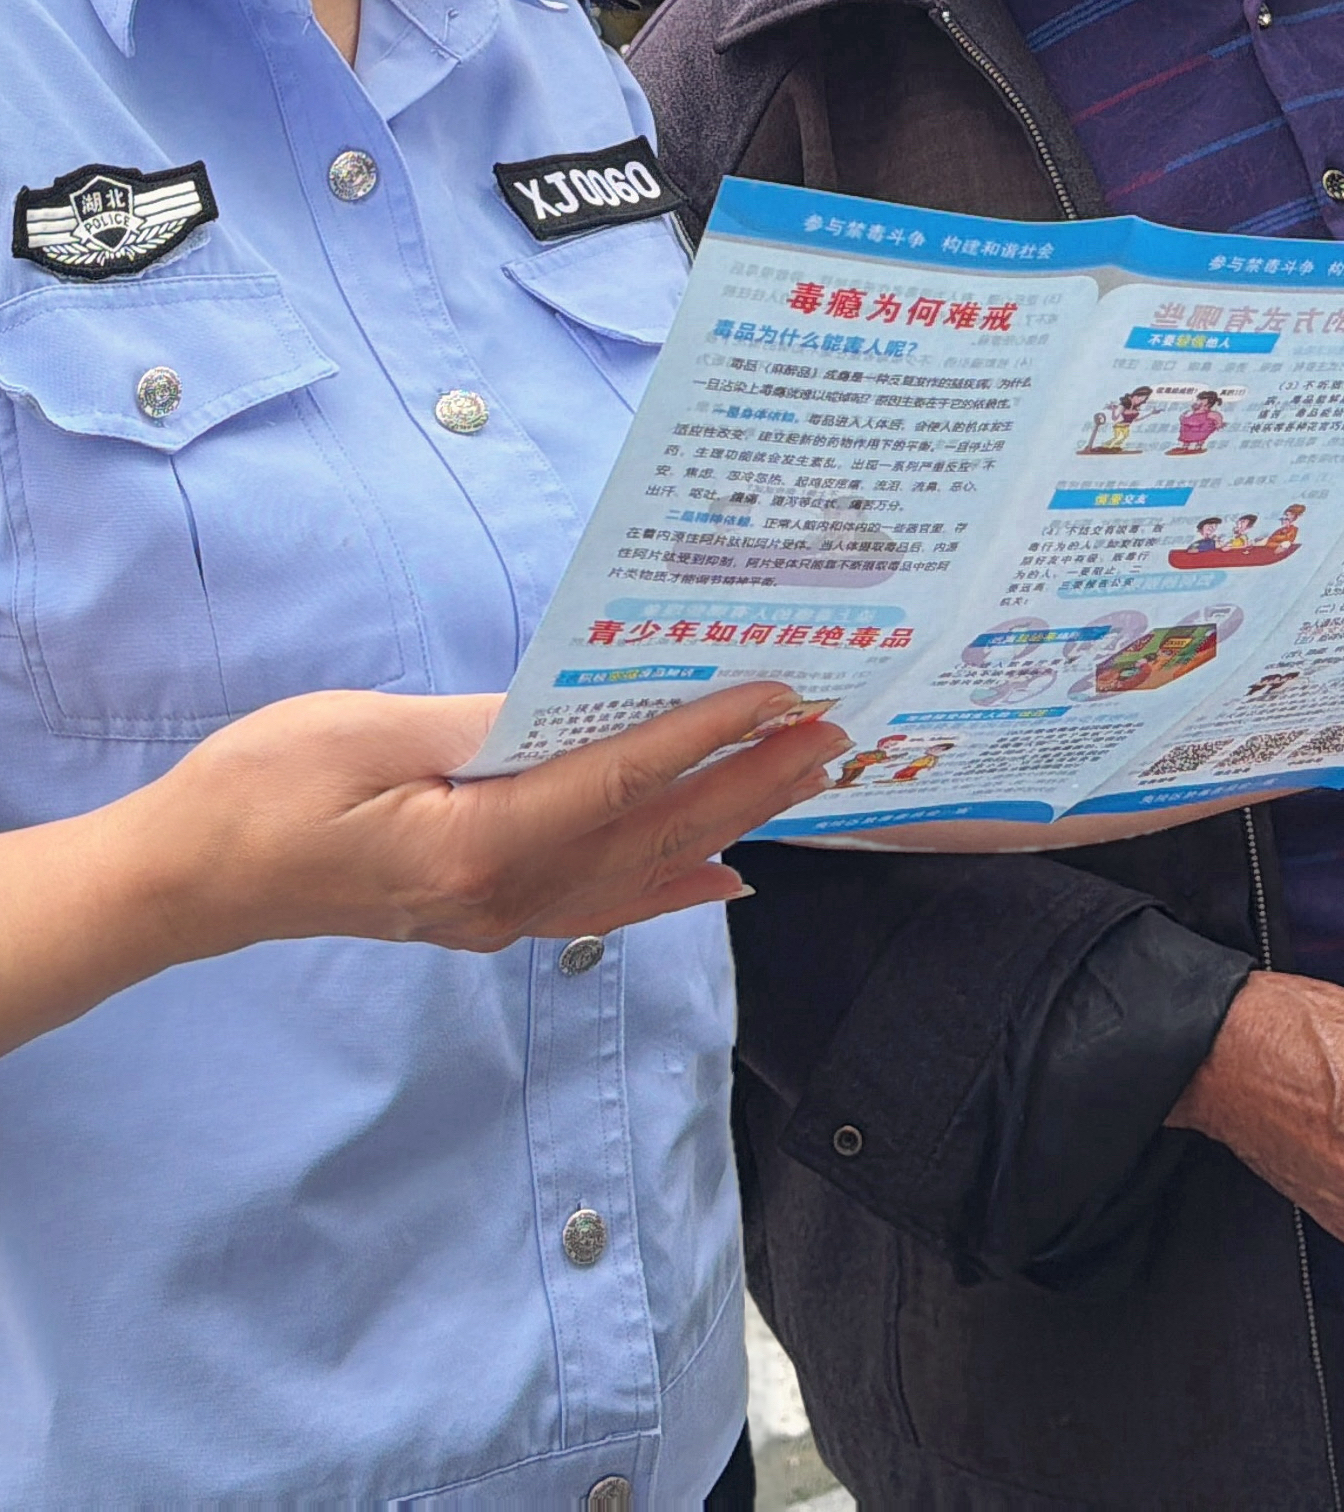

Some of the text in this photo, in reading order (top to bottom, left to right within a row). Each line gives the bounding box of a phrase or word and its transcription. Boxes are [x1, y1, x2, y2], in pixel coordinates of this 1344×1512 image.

[80, 188, 127, 216] 湖北
[512, 160, 662, 220] XJ0060
[85, 215, 131, 236] POLICE
[801, 212, 1057, 261] 参与禁毒斗争 构建和谐社会
[1207, 254, 1316, 277] 参与禁毒斗争
[785, 280, 1020, 333] 毒瘾为何难戒
[587, 618, 916, 650] 青少年如何拒绝毒品
